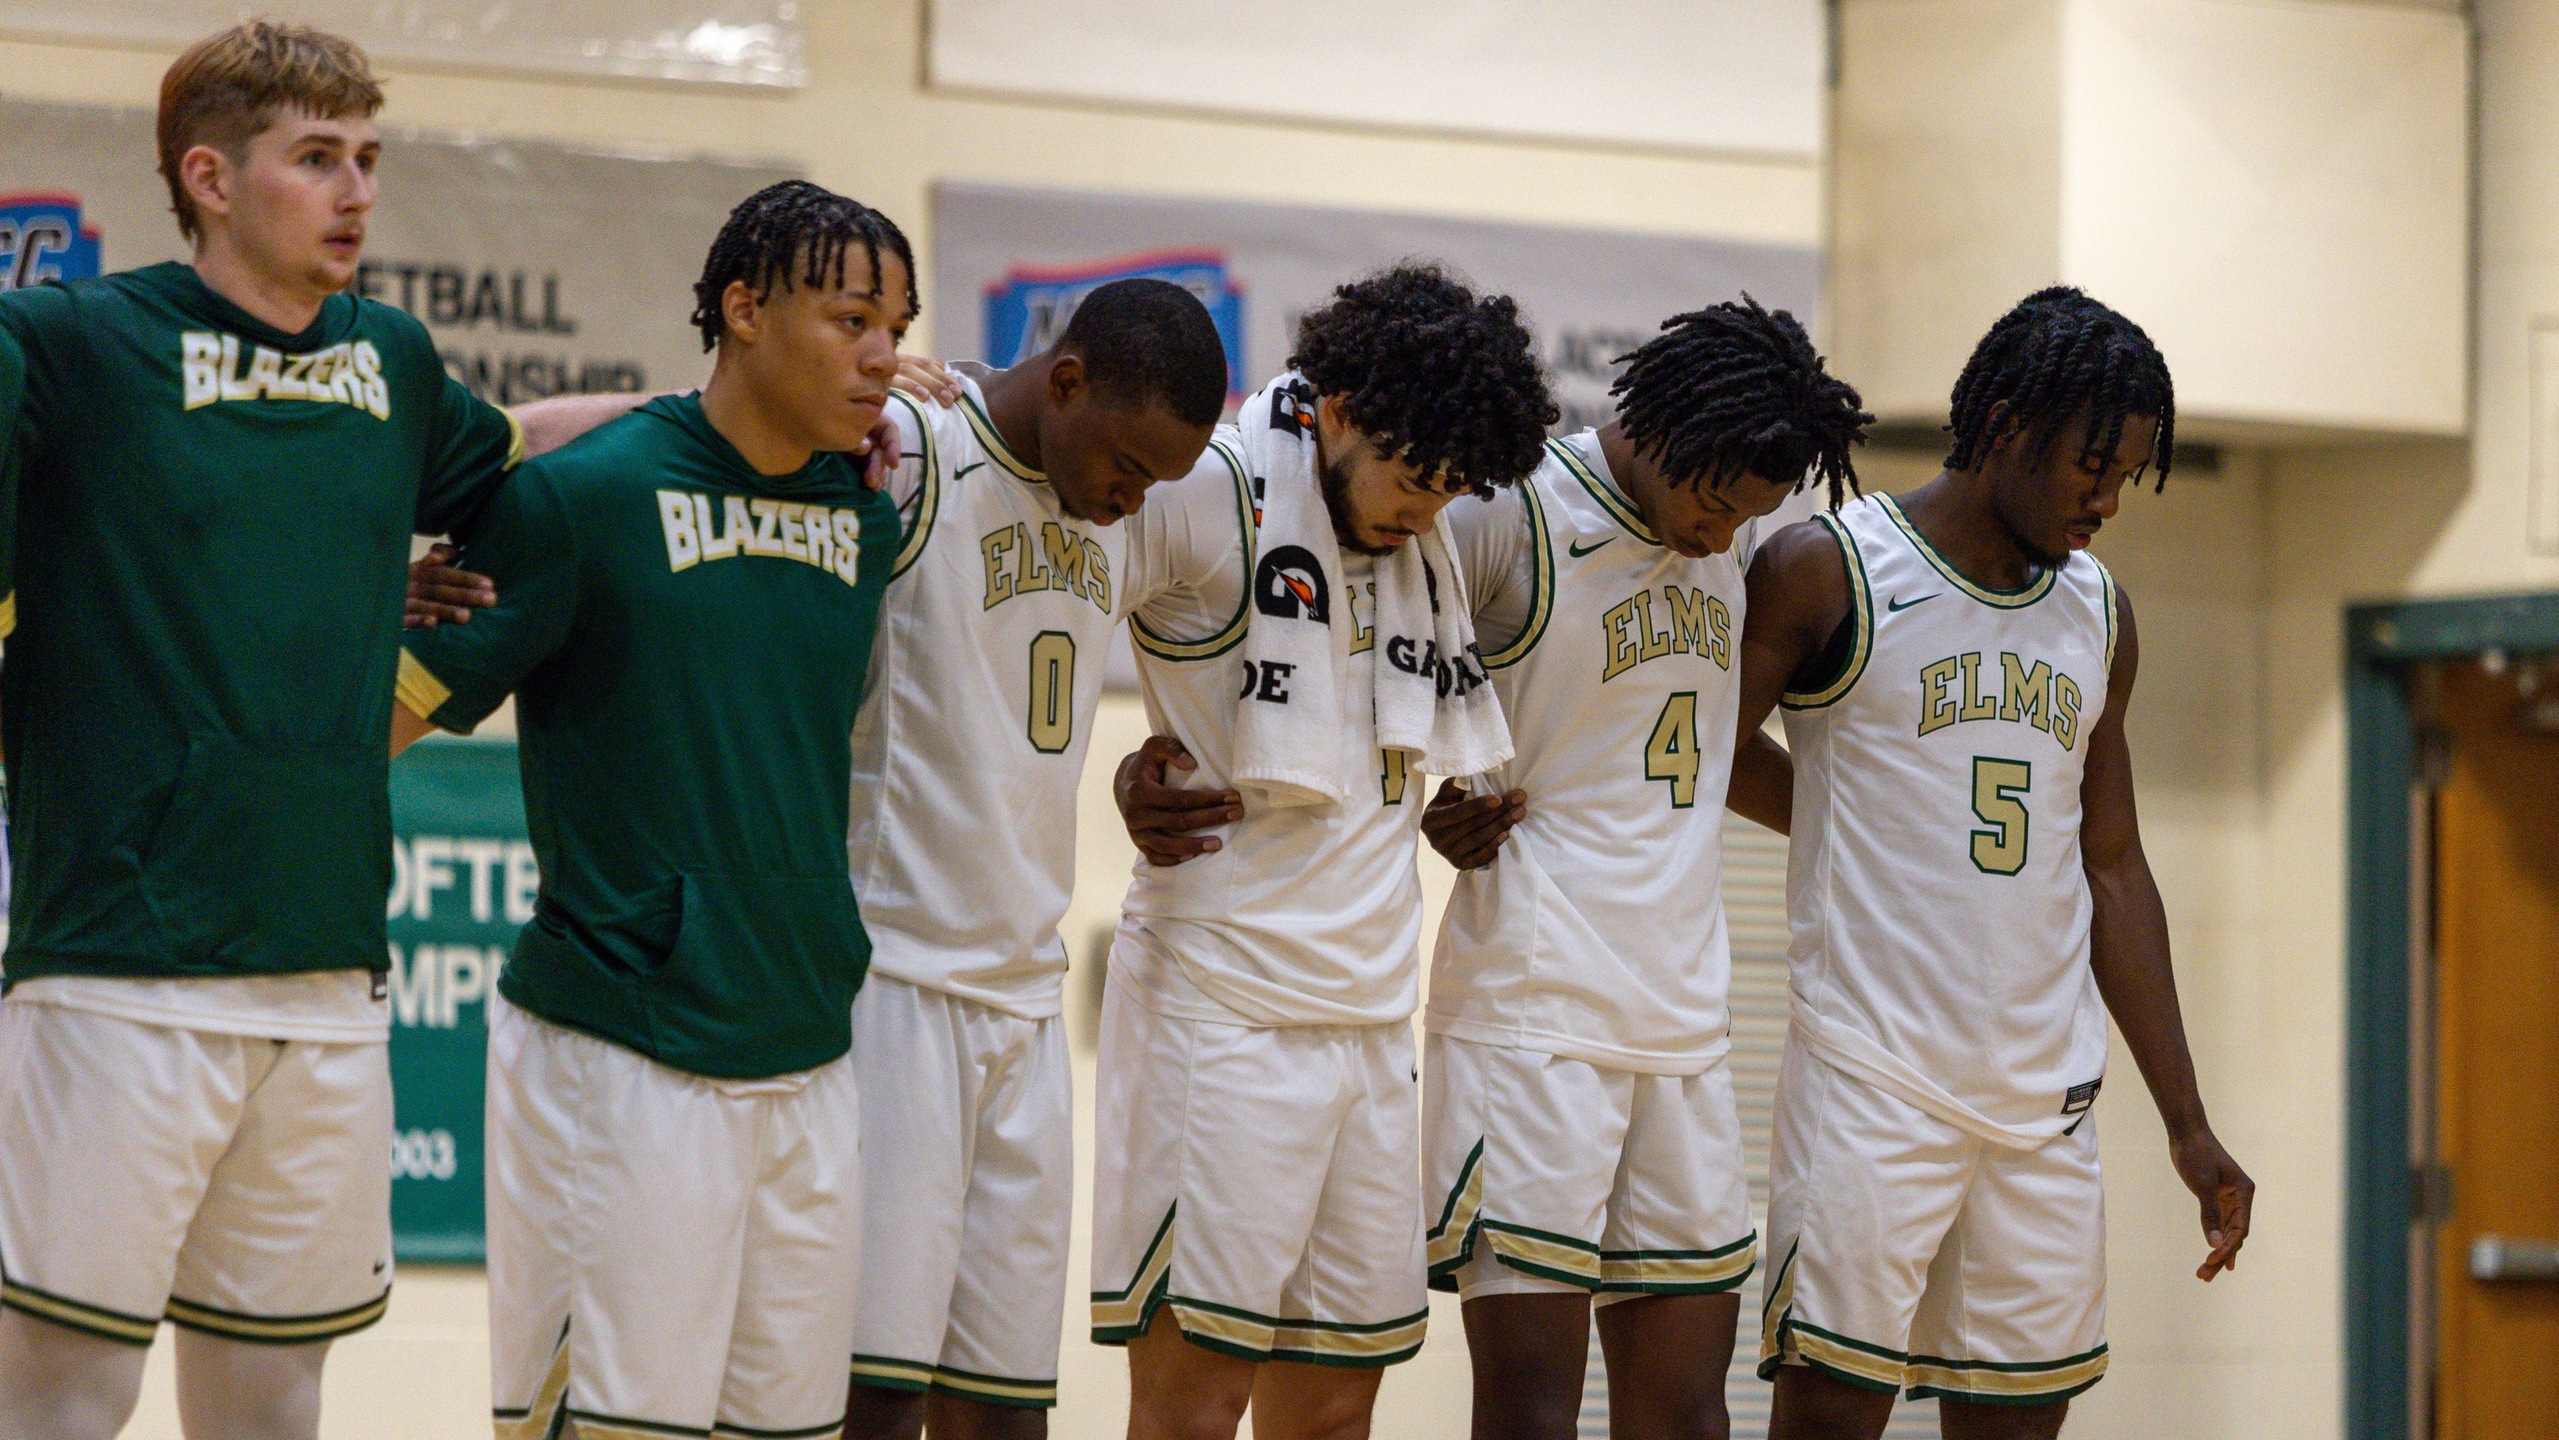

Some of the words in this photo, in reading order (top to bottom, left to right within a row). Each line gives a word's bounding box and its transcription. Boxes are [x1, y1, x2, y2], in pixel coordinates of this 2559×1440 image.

[356, 258, 578, 338] ETBALL
[181, 330, 391, 421] BLAZERS
[656, 489, 861, 588] BLAZERS
[980, 521, 1111, 615] ELMS
[1602, 585, 1731, 684] ELMS
[1027, 629, 1076, 755] 0
[1918, 651, 2082, 752] ELMS
[1645, 691, 1701, 809] 4
[1969, 755, 2031, 877] 5
